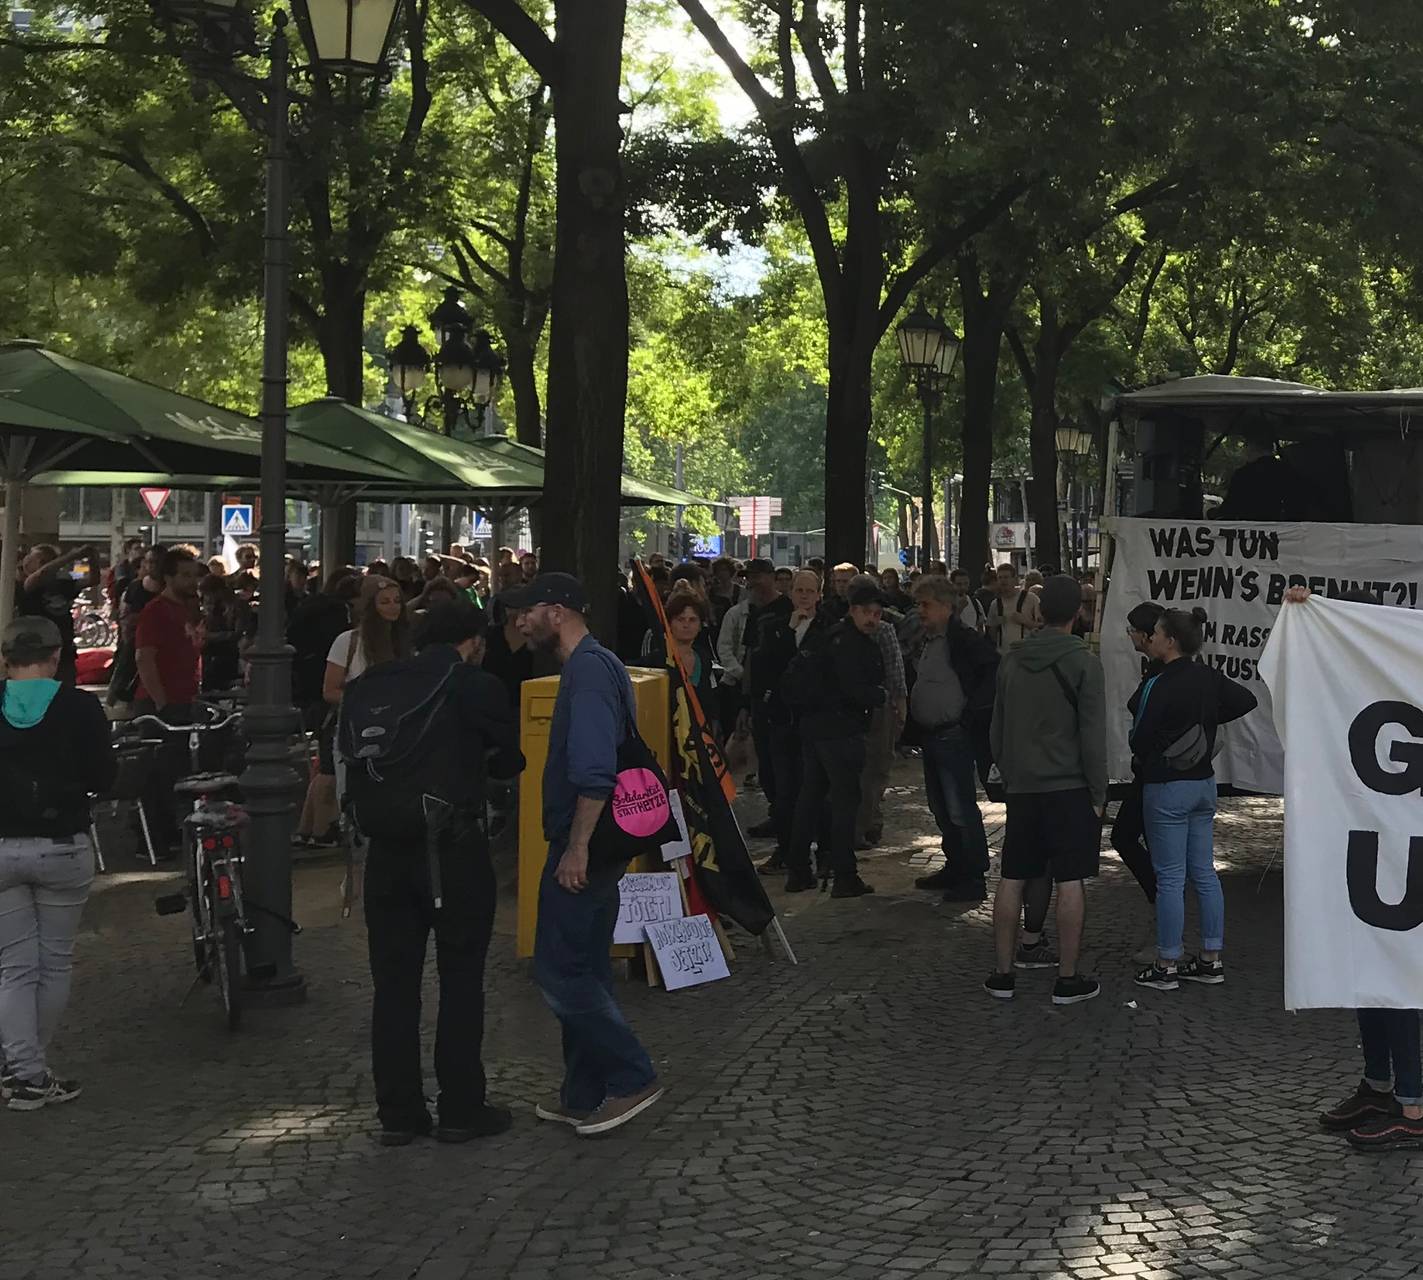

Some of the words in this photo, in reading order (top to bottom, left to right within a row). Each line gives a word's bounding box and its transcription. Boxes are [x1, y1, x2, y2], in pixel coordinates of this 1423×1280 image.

[1149, 526, 1214, 558] WAS
[1218, 528, 1279, 561] TUN
[1147, 565, 1259, 602] WENN'S
